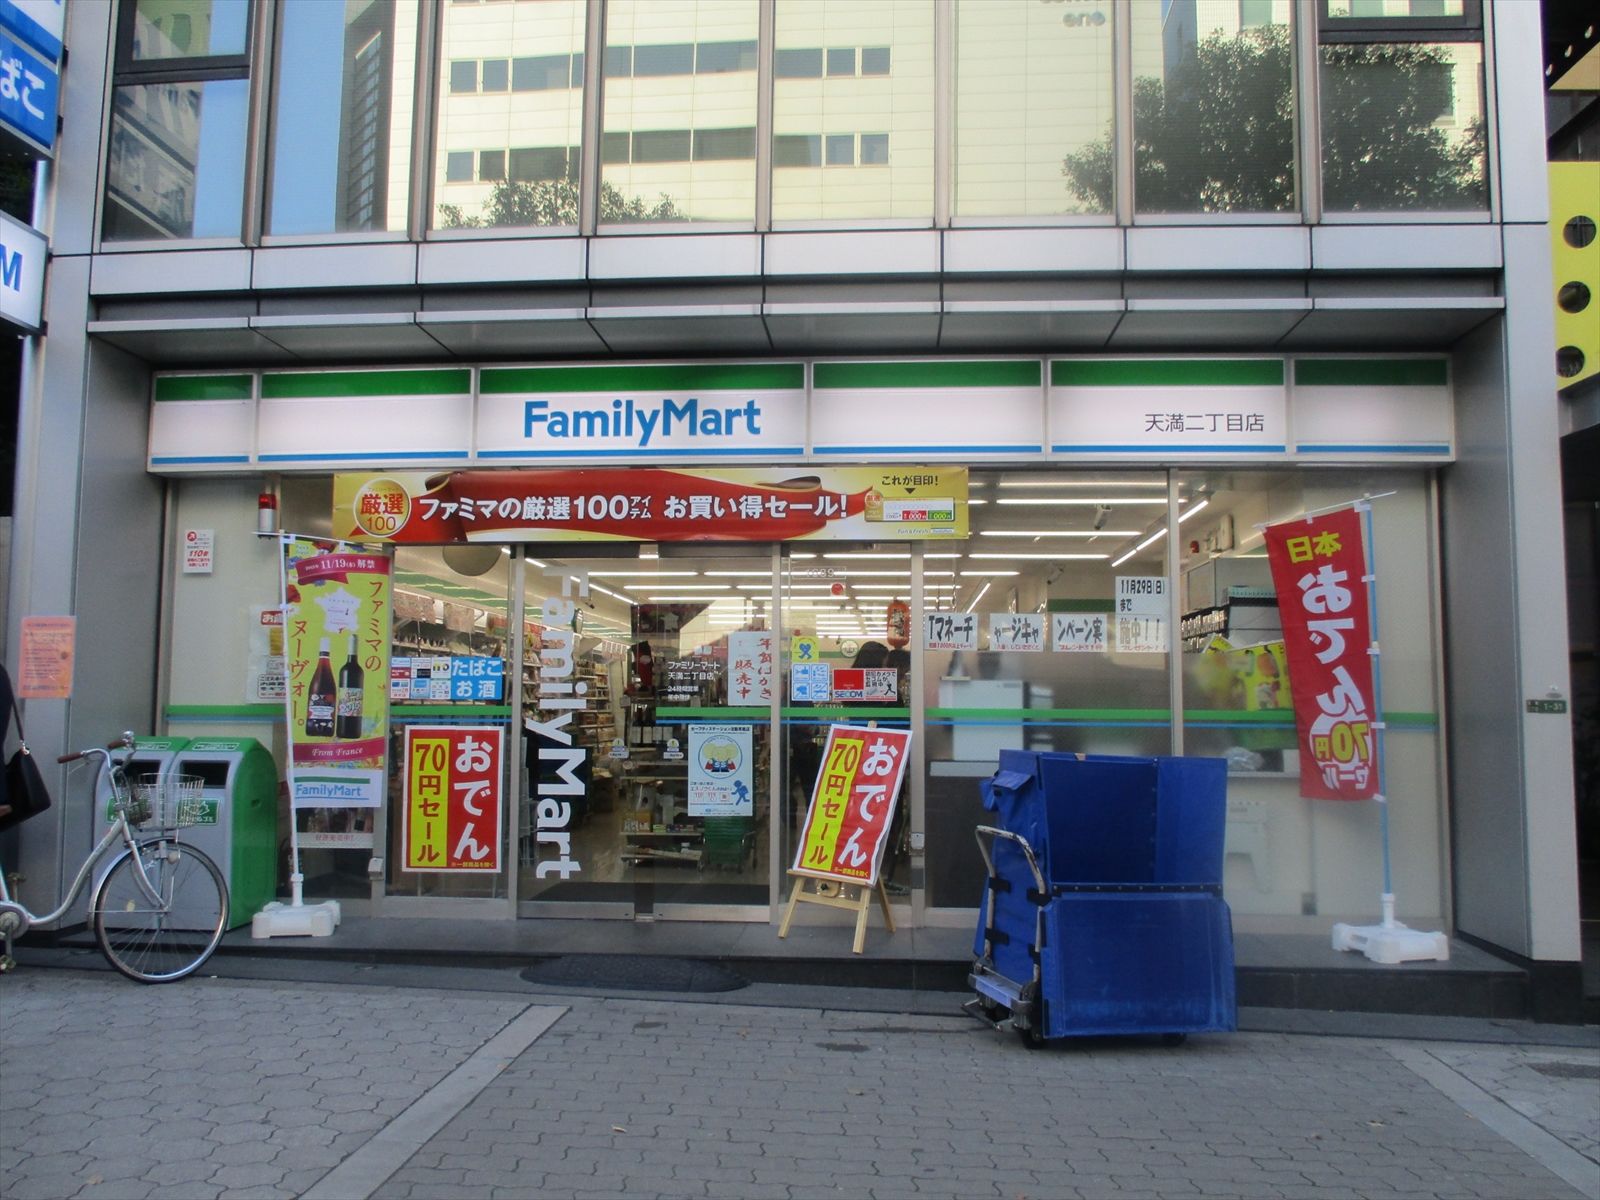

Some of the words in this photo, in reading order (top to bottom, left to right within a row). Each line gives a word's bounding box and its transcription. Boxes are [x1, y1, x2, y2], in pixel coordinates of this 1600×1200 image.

[524, 398, 761, 447] FamilyMart
[1144, 412, 1265, 433] 天満二丁目店
[881, 475, 939, 487] これが目印!
[360, 493, 404, 516] 厳選
[664, 494, 847, 518] お買い得セール!
[366, 516, 396, 531] 100
[1121, 580, 1165, 594] 11月29日(日)
[1120, 598, 1132, 612] まで
[365, 581, 384, 672] ファミマの
[452, 659, 501, 677] たばこ
[668, 661, 720, 670] ファミリーマート
[457, 680, 496, 698] お酒
[735, 660, 754, 699] 販売中
[834, 690, 863, 698] SECOM
[525, 566, 589, 879] FamilyMart
[312, 748, 334, 757] From
[337, 747, 363, 757] France
[295, 784, 361, 798] FamilyMart
[453, 735, 493, 860] おでん
[415, 744, 446, 863] 70円セール
[809, 743, 857, 864] 70円セール
[838, 738, 898, 867] おでん
